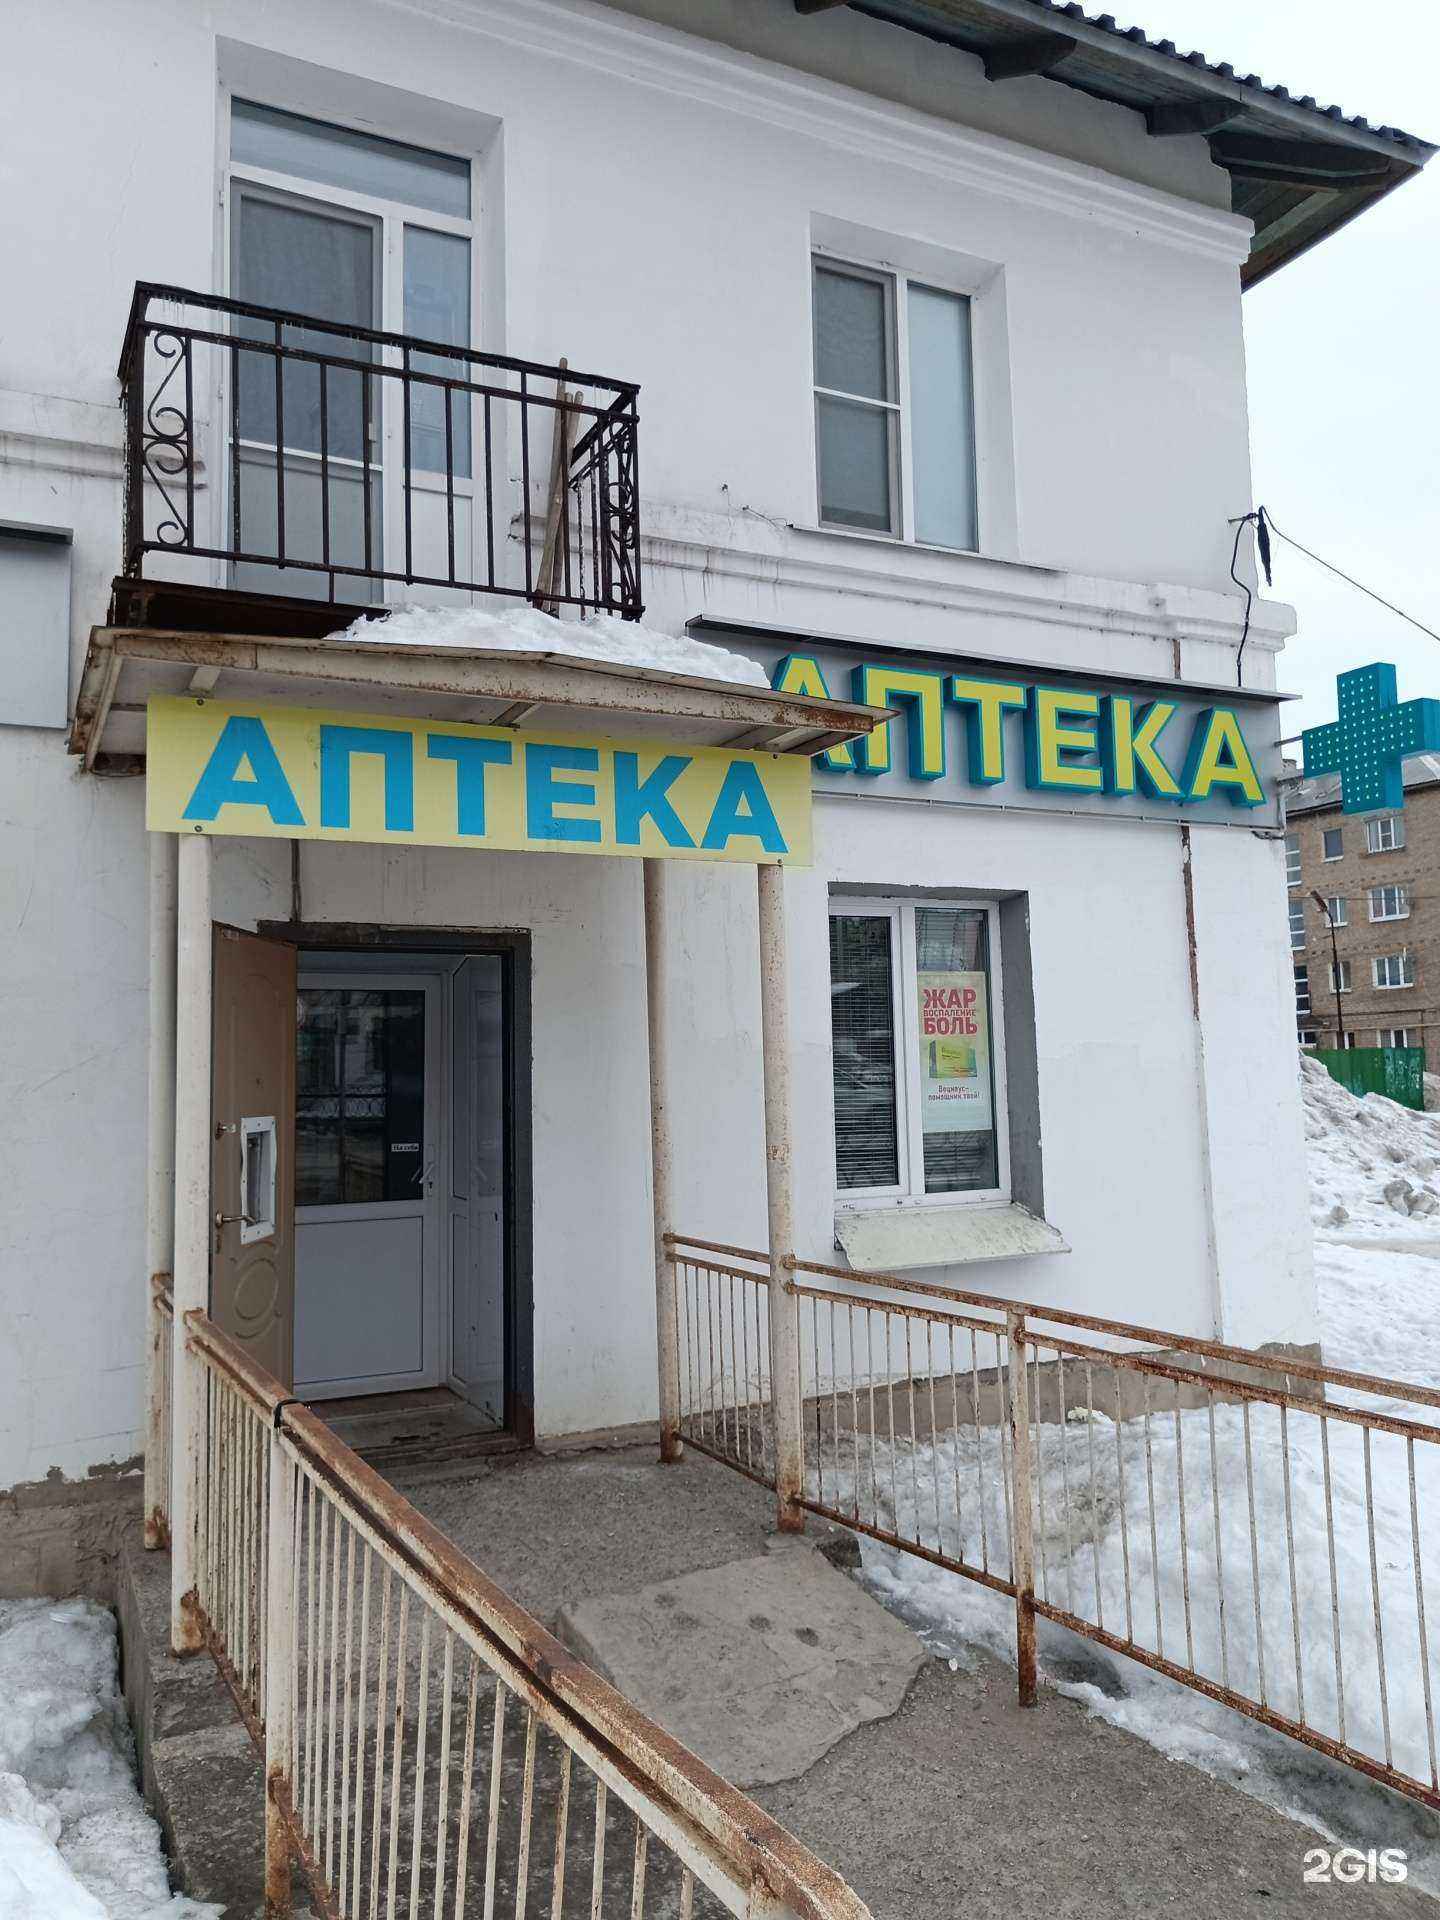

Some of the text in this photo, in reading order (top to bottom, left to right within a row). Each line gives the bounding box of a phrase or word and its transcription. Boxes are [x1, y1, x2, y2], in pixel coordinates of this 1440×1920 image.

[181, 714, 790, 854] АПТЕКА
[923, 988, 976, 1009] ЖАР
[923, 1009, 976, 1017] ВОСПАЛЕНИЕ
[924, 1017, 977, 1035] БОЛЬ
